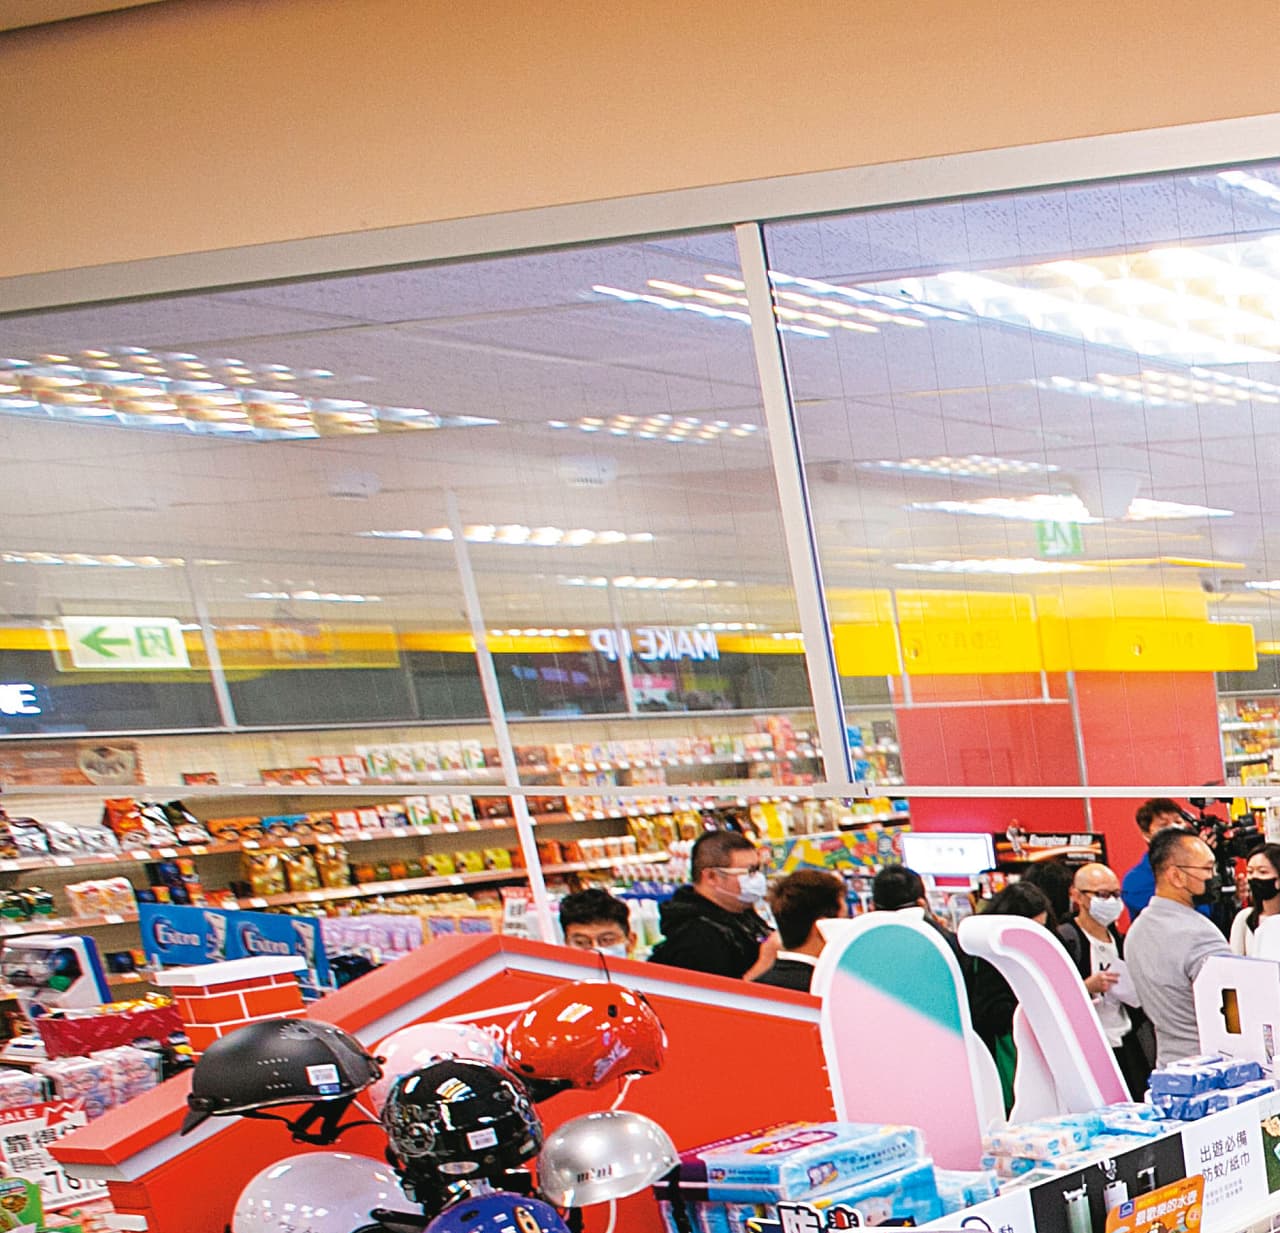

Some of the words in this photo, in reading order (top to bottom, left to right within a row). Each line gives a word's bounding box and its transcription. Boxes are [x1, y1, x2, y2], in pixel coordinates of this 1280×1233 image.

[1200, 1130, 1249, 1164] 出遊必備
[577, 1164, 614, 1183] mini
[1202, 1152, 1251, 1183] 防蚊/紙巾
